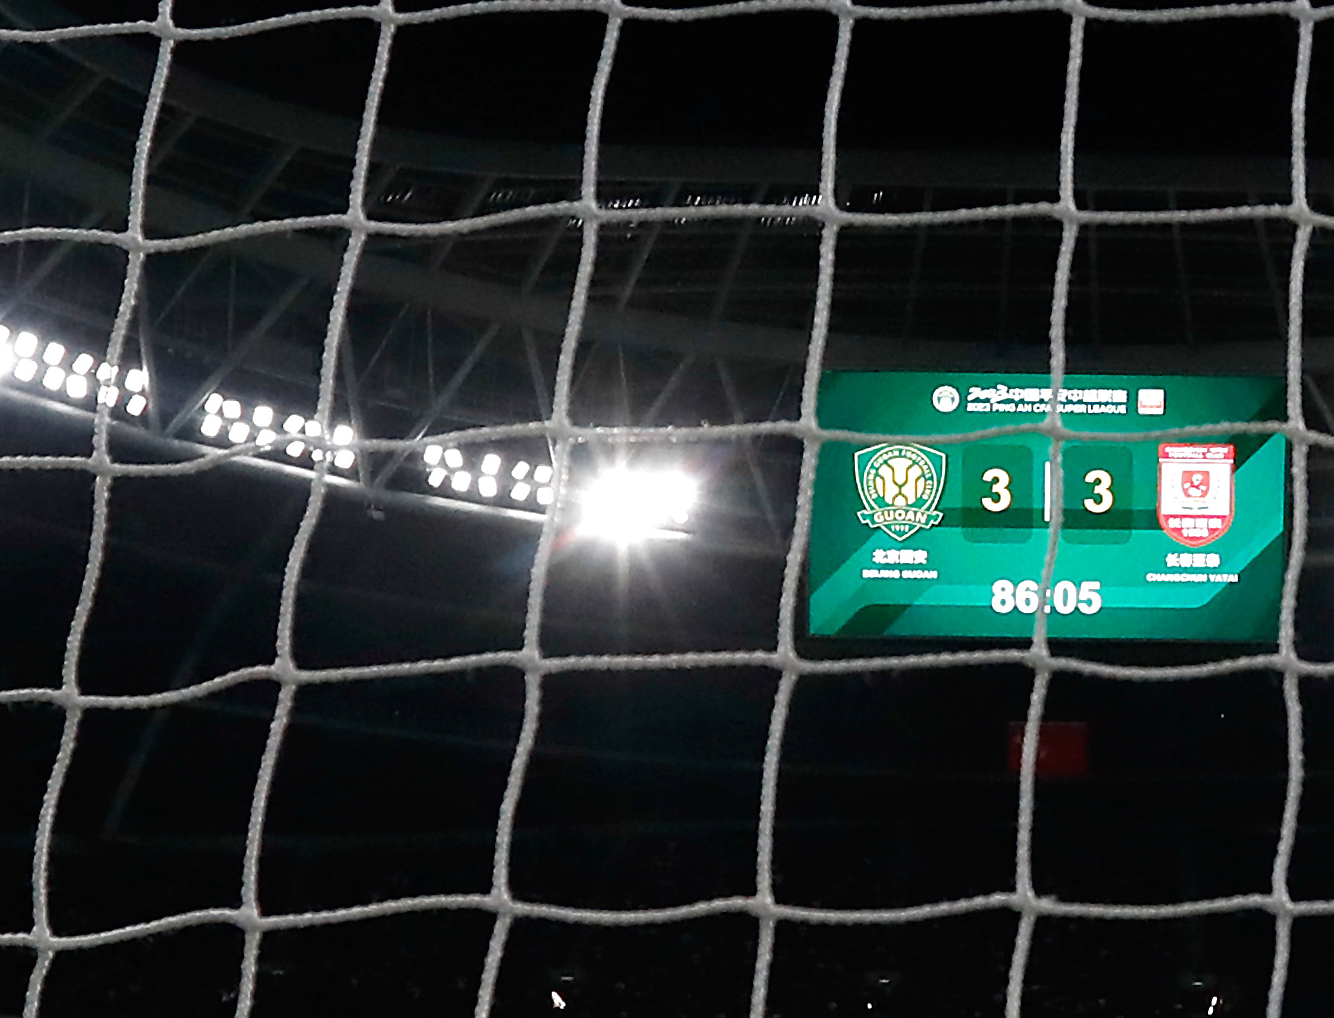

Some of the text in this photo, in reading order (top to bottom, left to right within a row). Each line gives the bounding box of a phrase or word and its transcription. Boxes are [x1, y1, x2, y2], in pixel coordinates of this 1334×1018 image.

[981, 468, 1013, 512] 3
[1083, 469, 1115, 513] 3
[873, 509, 928, 524] GUOAN
[991, 578, 1103, 615] 86:05
[1208, 574, 1239, 583] YATAI
